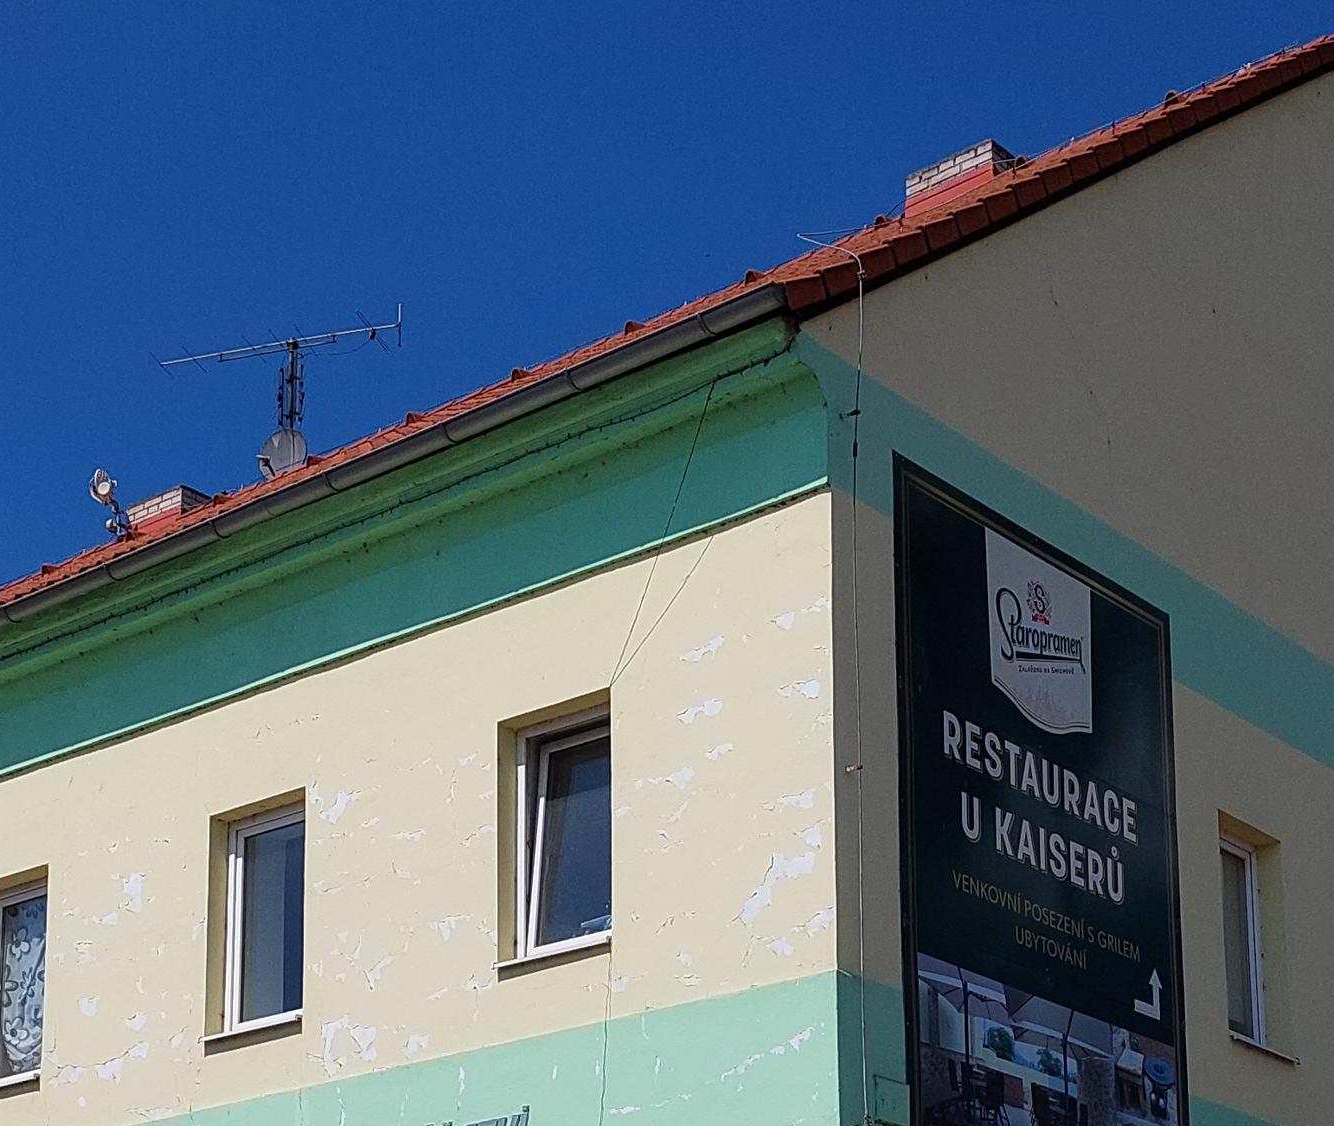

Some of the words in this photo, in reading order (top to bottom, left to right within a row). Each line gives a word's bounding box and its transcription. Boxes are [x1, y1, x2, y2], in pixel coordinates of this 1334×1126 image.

[995, 587, 1085, 666] Staropramen
[942, 709, 1138, 846] RESTAURACE
[960, 791, 982, 844] U
[994, 805, 1125, 905] KAISERŮ
[952, 869, 1021, 914] VENKOVNÍ
[1024, 898, 1085, 940] POSEZENÍ
[1087, 926, 1095, 942] S
[1097, 930, 1141, 963] GRILEM
[1015, 925, 1087, 970] UBYTOVÁNÍ
